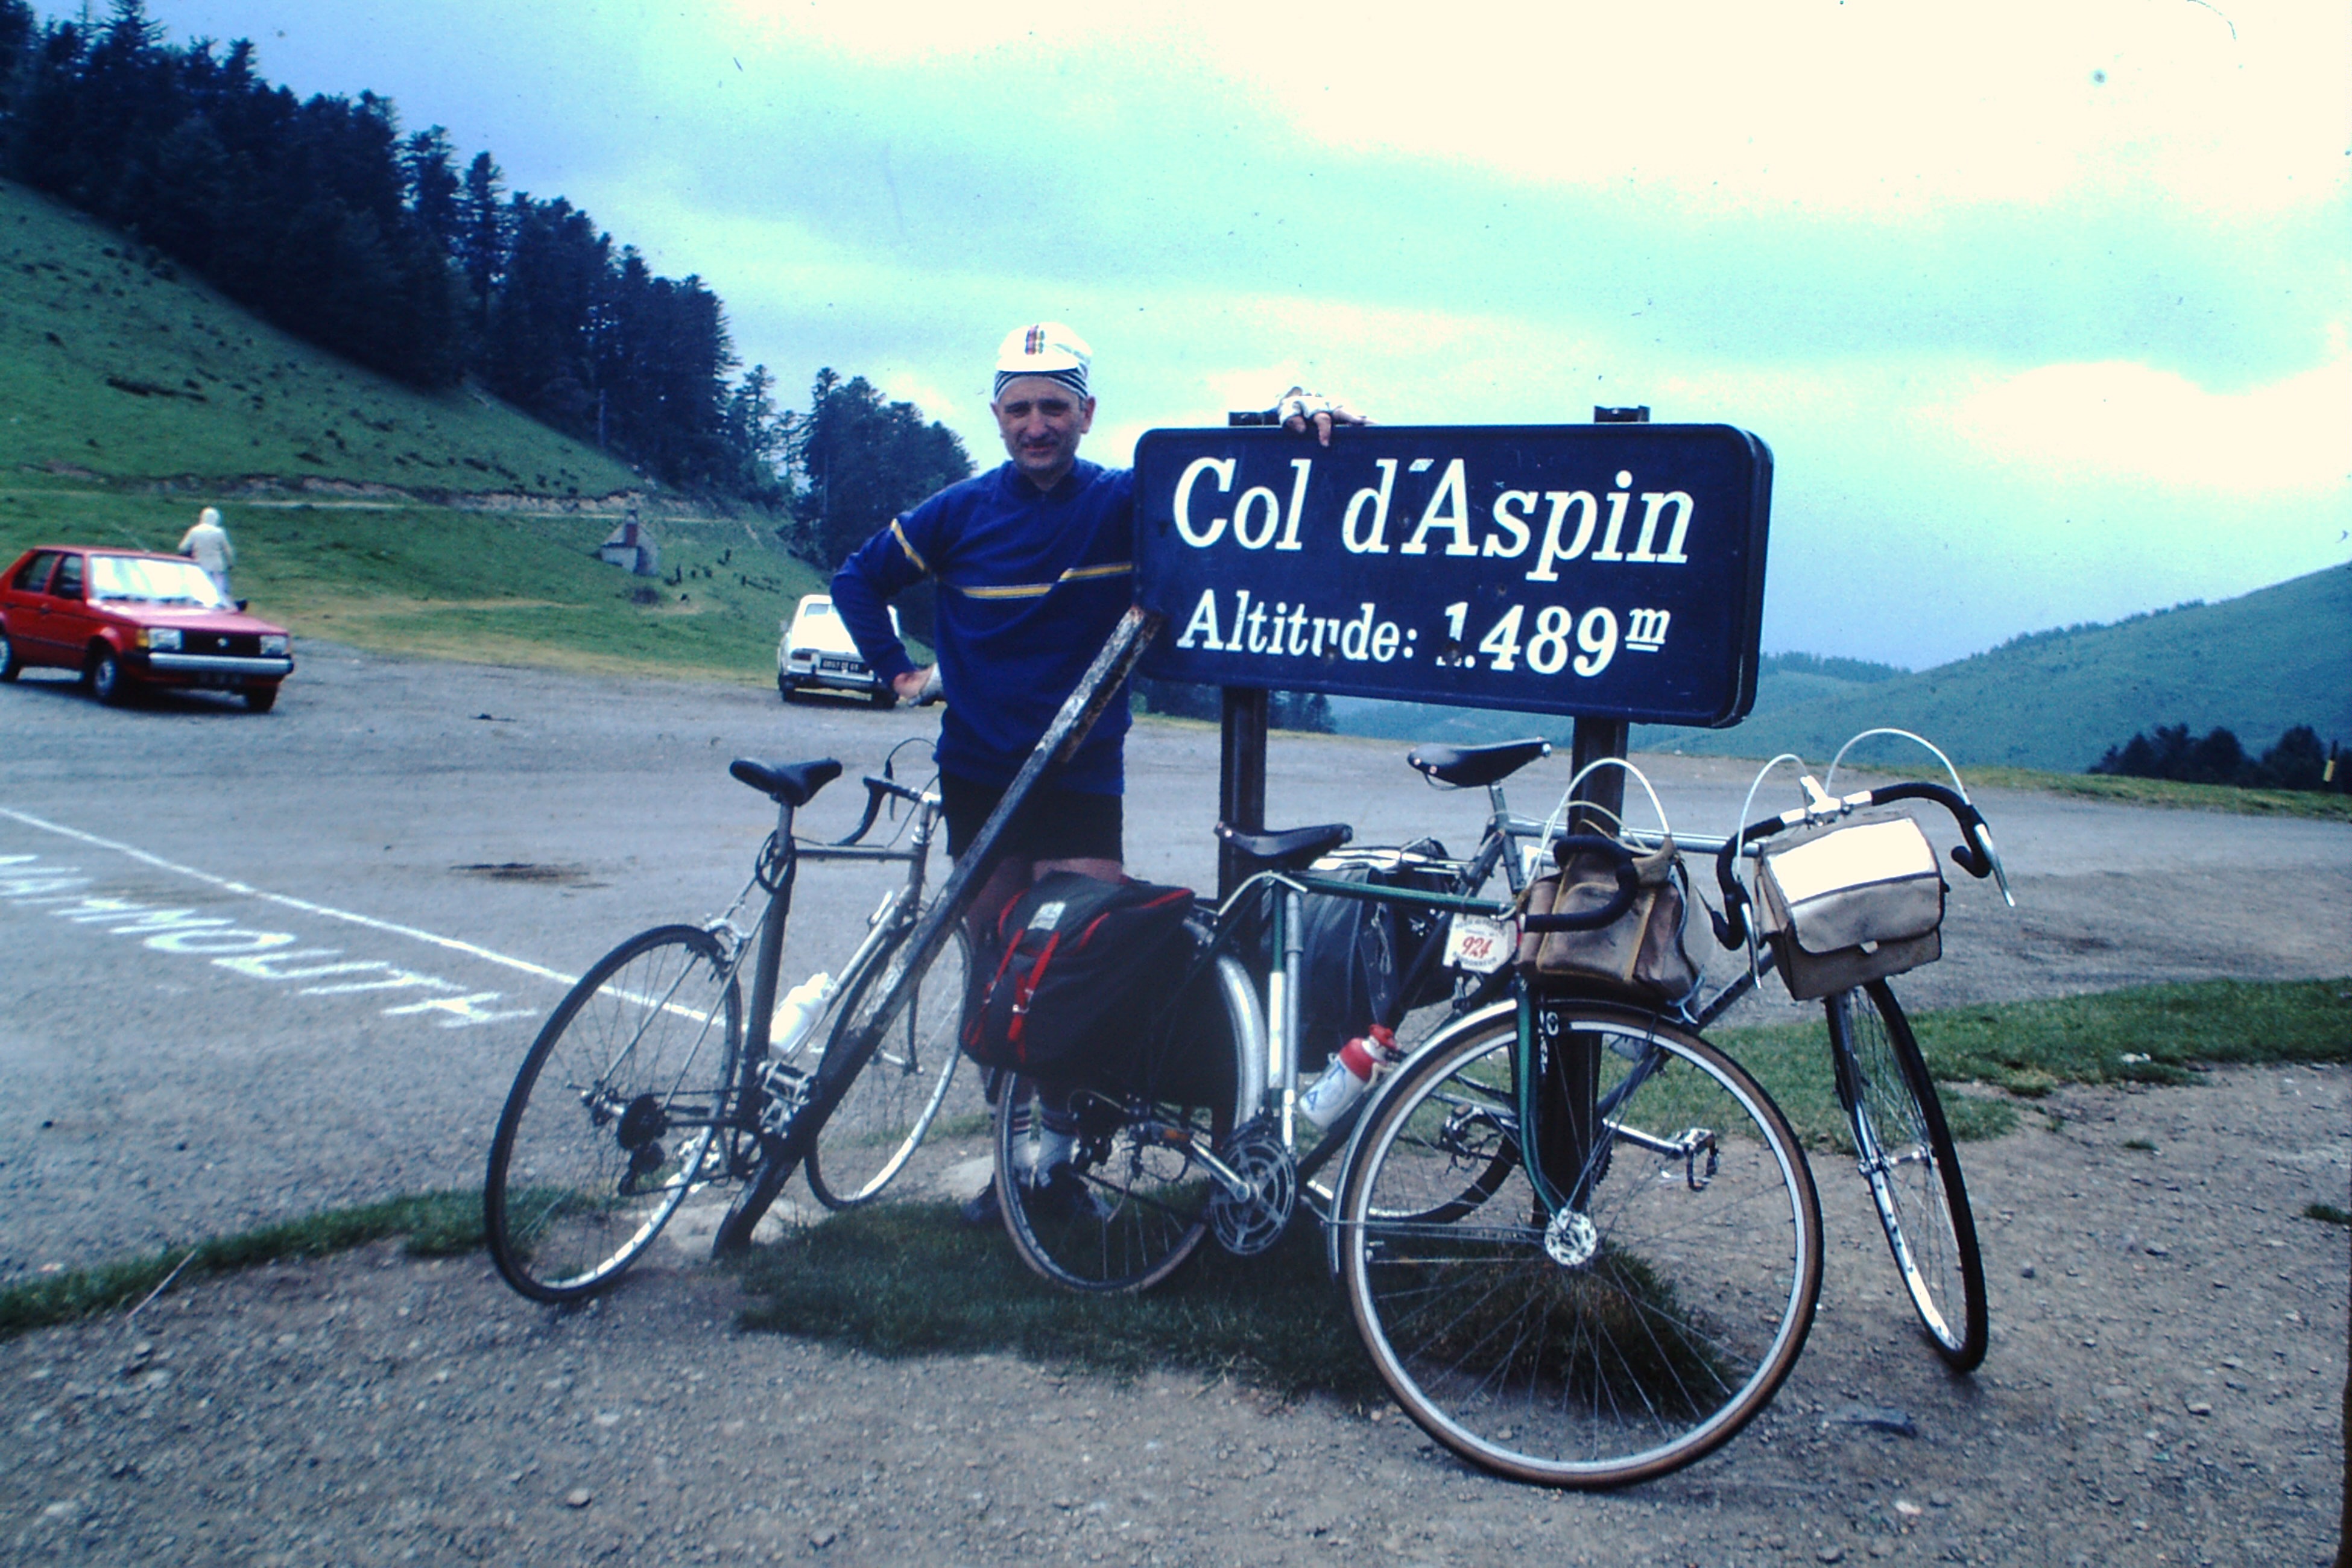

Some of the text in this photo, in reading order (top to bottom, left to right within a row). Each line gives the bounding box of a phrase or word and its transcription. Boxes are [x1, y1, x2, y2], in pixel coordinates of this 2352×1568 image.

[1173, 457, 1693, 582] Col d'Aspin
[1177, 588, 1418, 662] Altitude:
[1462, 936, 1493, 958] 924
